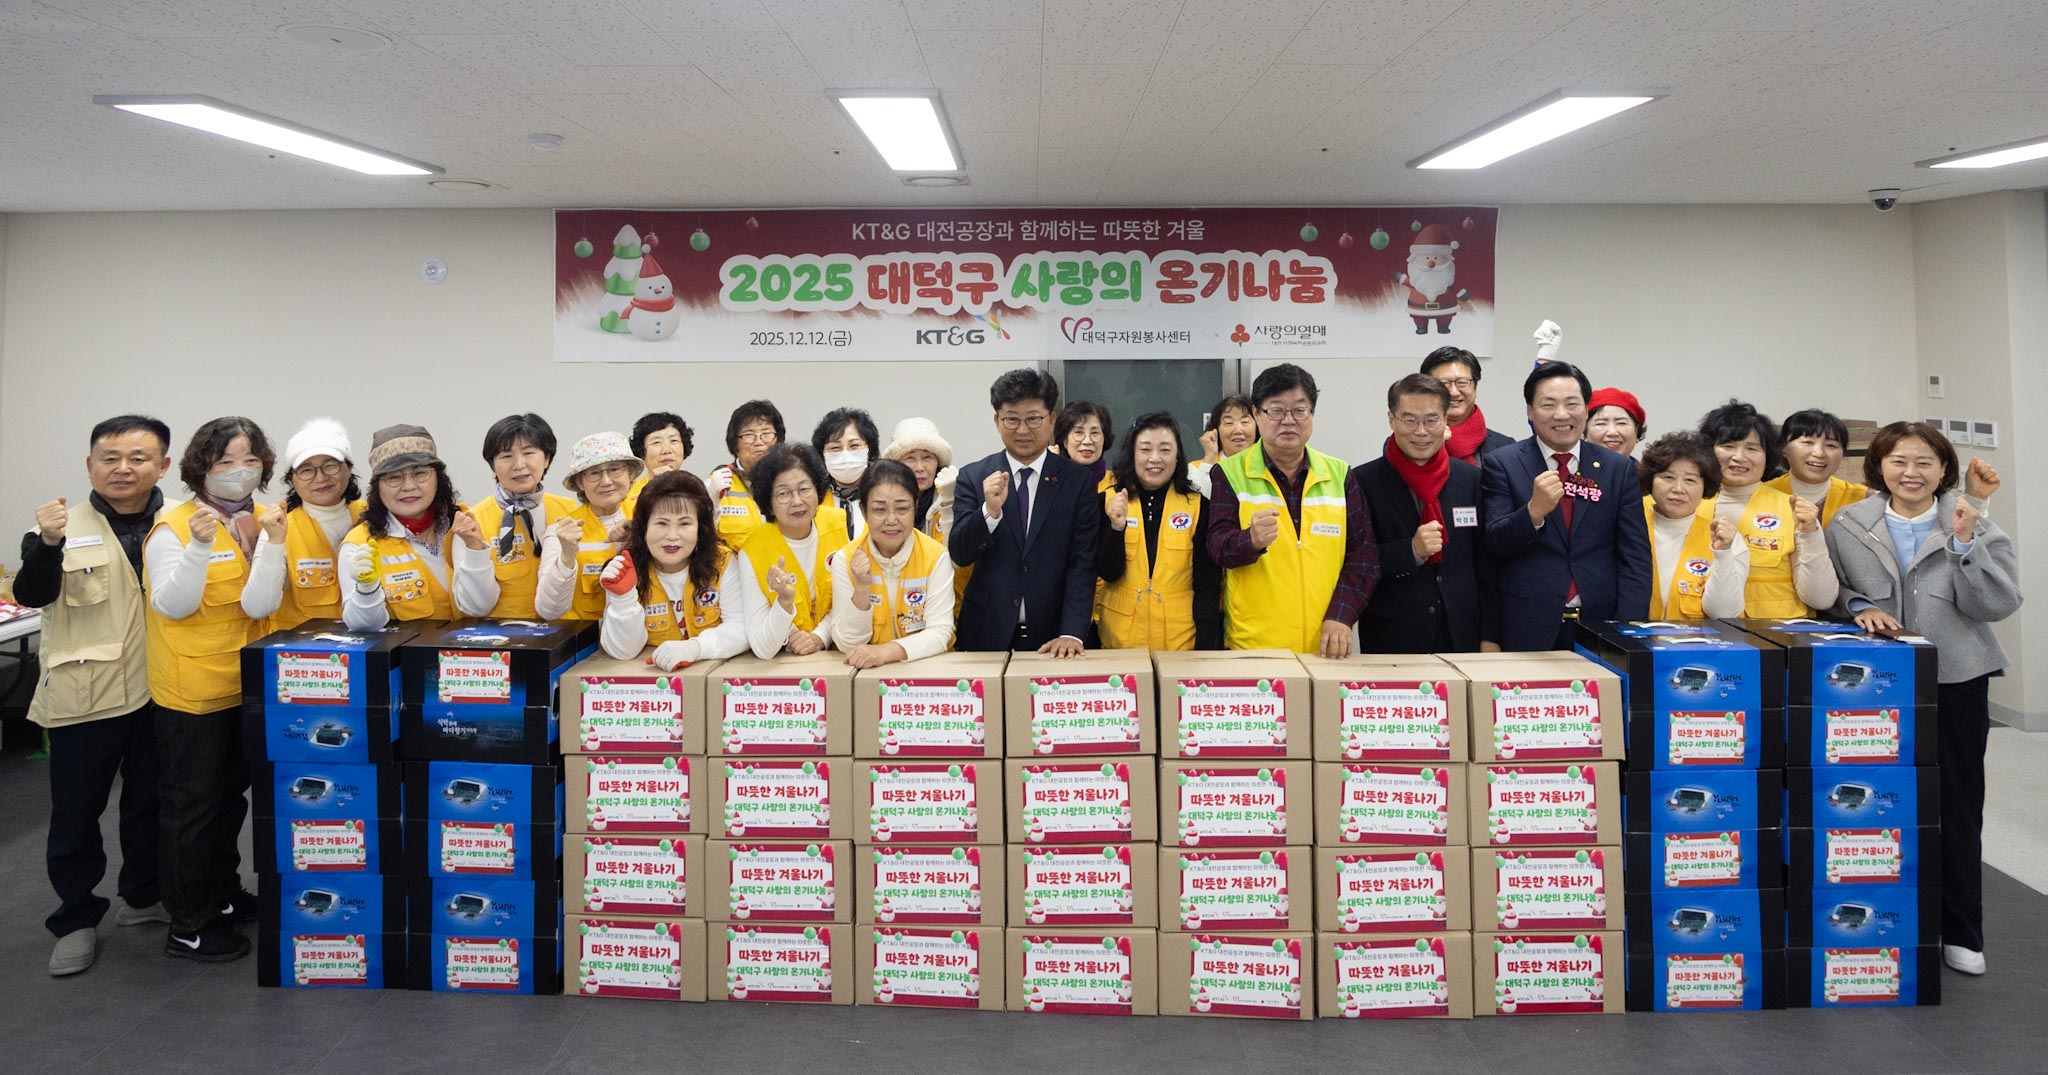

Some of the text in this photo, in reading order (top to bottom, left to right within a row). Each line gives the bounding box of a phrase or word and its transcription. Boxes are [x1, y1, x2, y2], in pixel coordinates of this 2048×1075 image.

[852, 220, 1205, 242] KT&G 대전공장과 함께하는 따뜻한 겨울
[729, 259, 1328, 306] 2025 대덕구 사랑의 온기나눔
[916, 326, 986, 346] KT&G
[1082, 329, 1191, 344] 대덕구자원봉사센터
[1254, 325, 1326, 340] 사랑의열매
[749, 330, 852, 348] 2025.12.12.(금)
[1564, 482, 1603, 502] 전석광
[284, 669, 341, 678] 따뜻한 겨울나기
[446, 668, 502, 677] 따뜻한 겨울나기
[591, 700, 672, 712] 따뜻한 겨울나기
[734, 702, 815, 714] 따뜻한 겨울나기
[890, 703, 973, 716] 따뜻한 겨울나기
[1043, 700, 1126, 713] 따뜻한 겨울나기
[1190, 704, 1274, 716] 따뜻한 겨울나기
[1505, 705, 1588, 718] 따뜻한 겨울나기
[1352, 706, 1437, 719] 따뜻한 겨울나기
[589, 717, 674, 727] 대덕구 사랑의 온기나눔
[888, 720, 976, 730] 대덕구 사랑의 온기나눔
[1188, 720, 1277, 731] 대덕구 사랑의 온기나눔
[1503, 721, 1592, 733] 대덕구 사랑의 온기나눔
[1350, 723, 1440, 734] 대덕구 사랑의 온기나눔
[1677, 729, 1736, 737] 따뜻한 겨울나기
[1833, 727, 1890, 736] 따뜻한 겨울나기
[598, 780, 679, 792] 따뜻한 겨울나기
[736, 785, 818, 798] 따뜻한 겨울나기
[882, 789, 965, 802] 따뜻한 겨울나기
[1034, 788, 1118, 802] 따뜻한 겨울나기
[1190, 793, 1274, 806] 따뜻한 겨울나기
[1353, 790, 1436, 804] 따뜻한 겨울나기
[1500, 790, 1584, 803] 따뜻한 겨울나기
[734, 802, 821, 812] 대덕구 사랑의 온기나눔
[1032, 805, 1122, 816] 대덕구 사랑의 온기나눔
[1350, 807, 1438, 820] 대덕구 사랑의 온기나눔
[300, 836, 357, 845] 따뜻한 겨울나기
[448, 838, 505, 848] 따뜻한 겨울나기
[1672, 850, 1731, 859] 따뜻한 겨울나기
[1834, 846, 1892, 855] 따뜻한 겨울나기
[595, 861, 674, 874] 따뜻한 겨울나기
[741, 868, 823, 880] 따뜻한 겨울나기
[885, 871, 968, 883] 따뜻한 겨울나기
[1036, 871, 1120, 884] 따뜻한 겨울나기
[593, 878, 677, 889] 대덕구 사랑의 온기나눔
[1192, 876, 1276, 889] 따뜻한 겨울나기
[1349, 878, 1433, 892] 따뜻한 겨울나기
[1508, 875, 1593, 888] 따뜻한 겨울나기
[883, 888, 972, 898] 대덕구 사랑의 온기나눔
[1189, 893, 1279, 904] 대덕구 사랑의 온기나눔
[1506, 892, 1596, 903] 대덕구 사랑의 온기나눔
[301, 951, 358, 959] 따뜻한 겨울나기
[591, 944, 670, 958] 따뜻한 겨울나기
[738, 949, 819, 962] 따뜻한 겨울나기
[453, 954, 510, 963] 따뜻한 겨울나기
[885, 952, 967, 966] 따뜻한 겨울나기
[736, 966, 822, 977] 대덕구 사랑의 온기나눔
[1035, 960, 1119, 973] 따뜻한 겨울나기
[1203, 961, 1289, 975] 따뜻한 겨울나기
[1348, 964, 1434, 978] 따뜻한 겨울나기
[1507, 960, 1591, 973] 따뜻한 겨울나기
[1832, 966, 1891, 975] 따뜻한 겨울나기
[1674, 971, 1734, 980] 따뜻한 겨울나기
[1032, 977, 1122, 988] 대덕구 사랑의 온기나눔
[1346, 980, 1438, 993] 대덕구 사랑의 온기나눔
